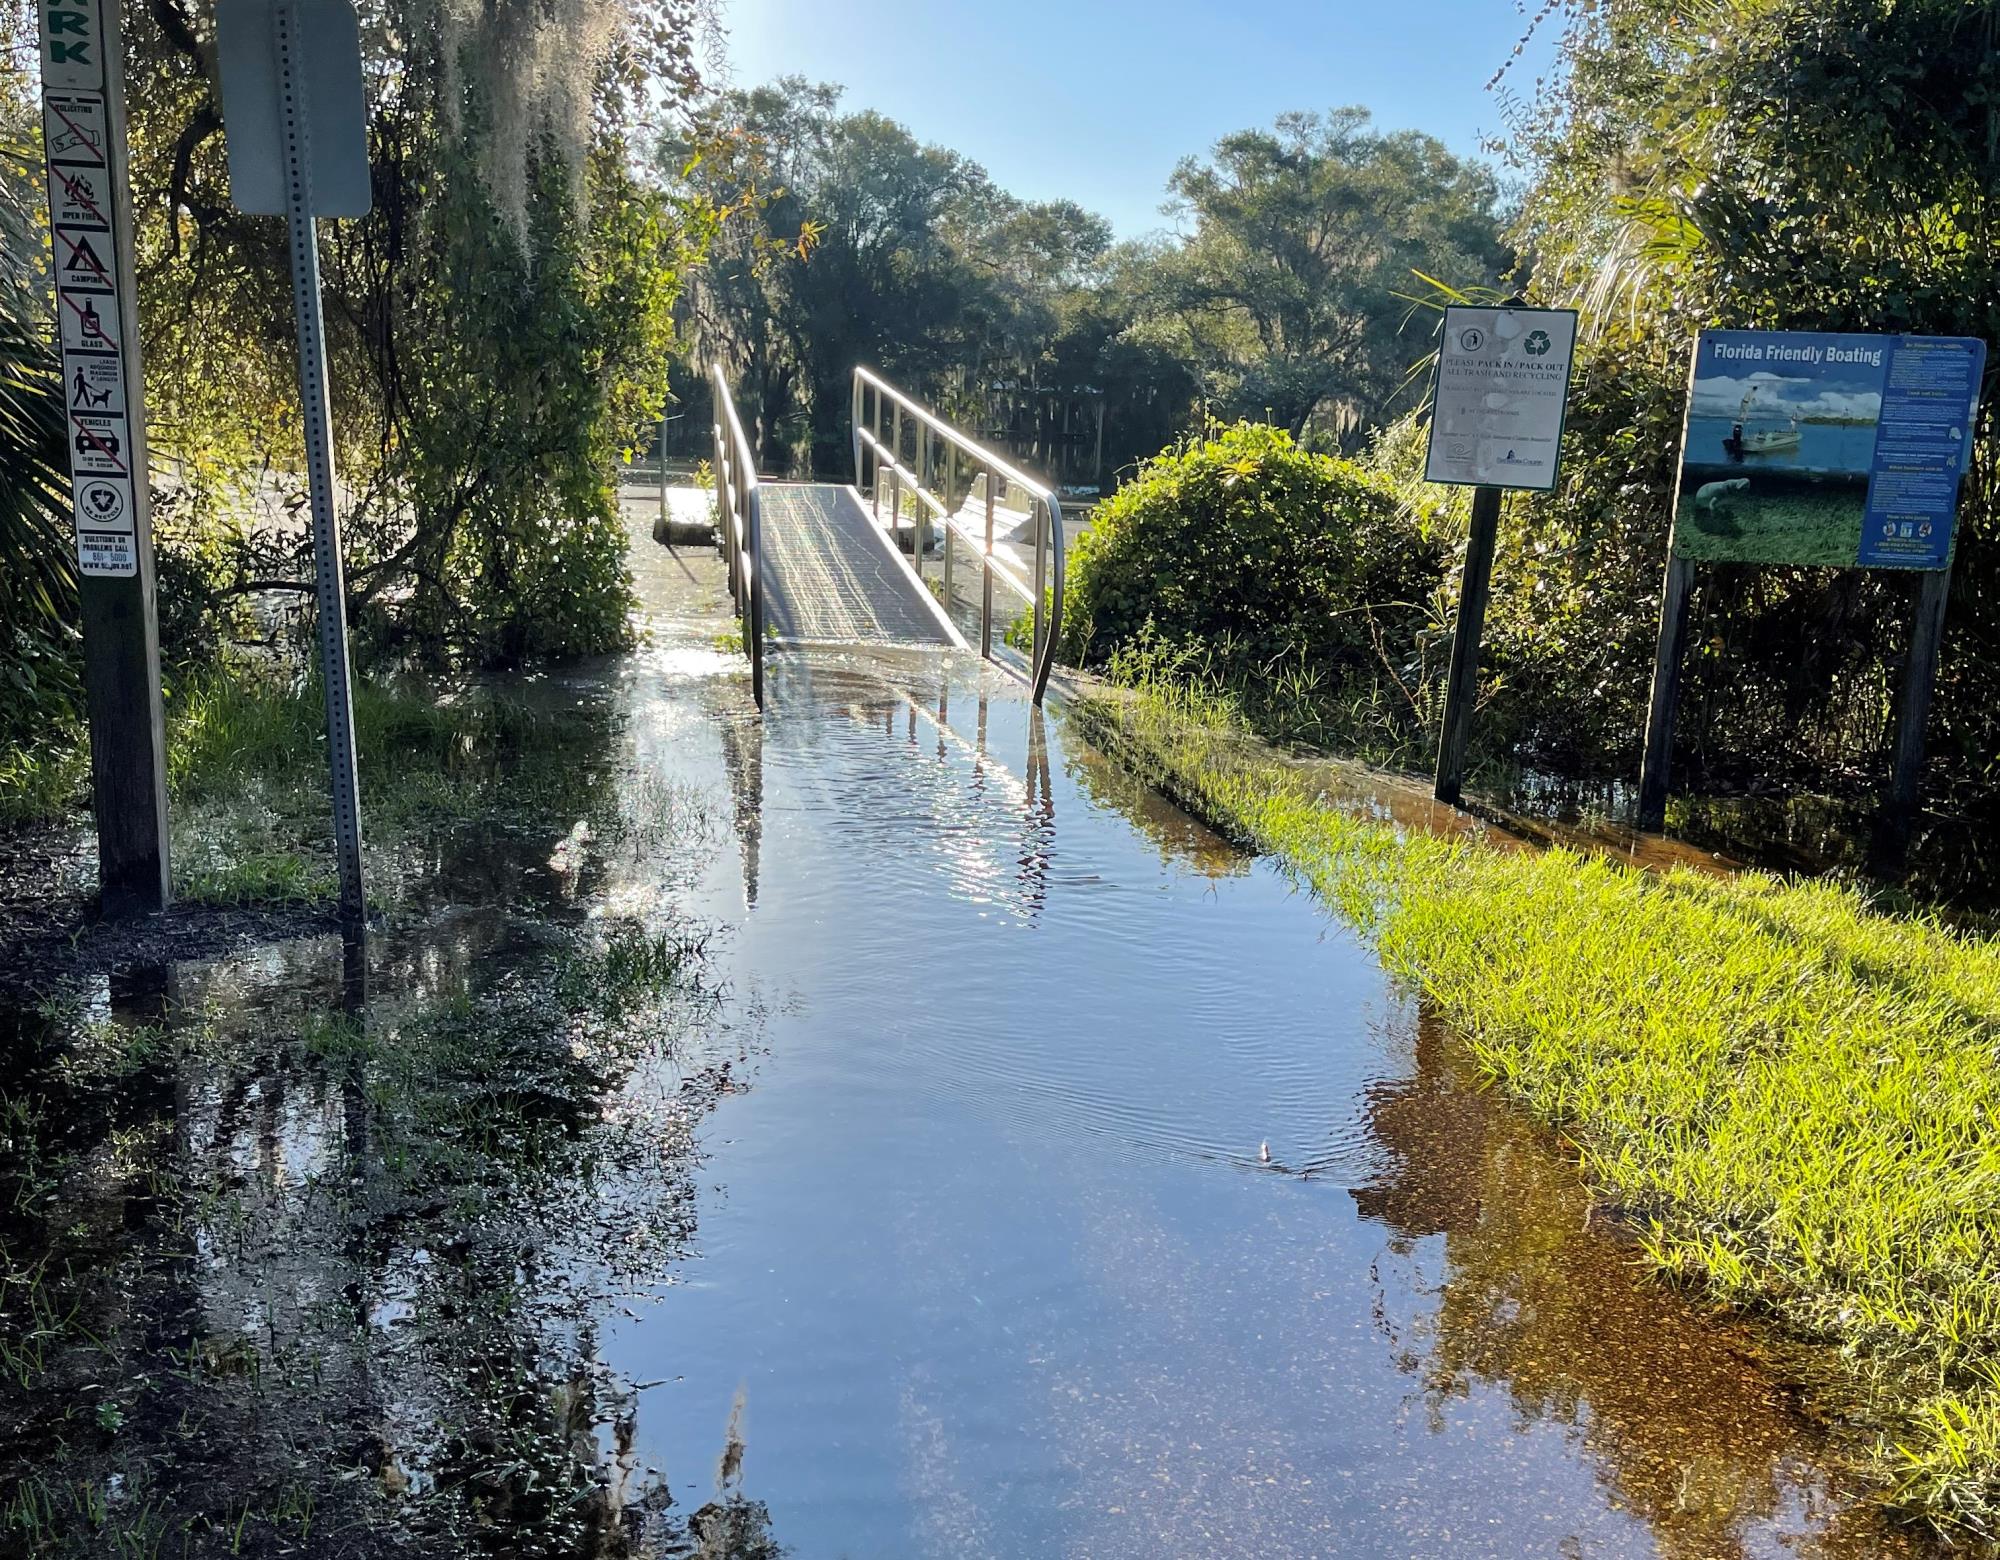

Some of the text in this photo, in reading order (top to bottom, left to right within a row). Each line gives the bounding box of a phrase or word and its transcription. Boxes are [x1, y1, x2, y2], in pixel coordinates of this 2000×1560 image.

[62, 211, 80, 220] OPEN
[71, 275, 103, 284] CAMPING
[81, 340, 103, 348] GLASS
[1714, 343, 1882, 367] Florida Friendly Boating
[1445, 359, 1474, 367] PLEASE
[1478, 359, 1502, 368] PACK
[1503, 361, 1513, 369] IN
[1519, 362, 1544, 371] PACK
[1545, 363, 1565, 372] OUT
[1446, 368, 1562, 381] ALL TRASH AND RECYCLING
[80, 418, 111, 427] VEHICLES
[94, 506, 120, 519] RECYCLE
[84, 535, 115, 543] QUESTIONS
